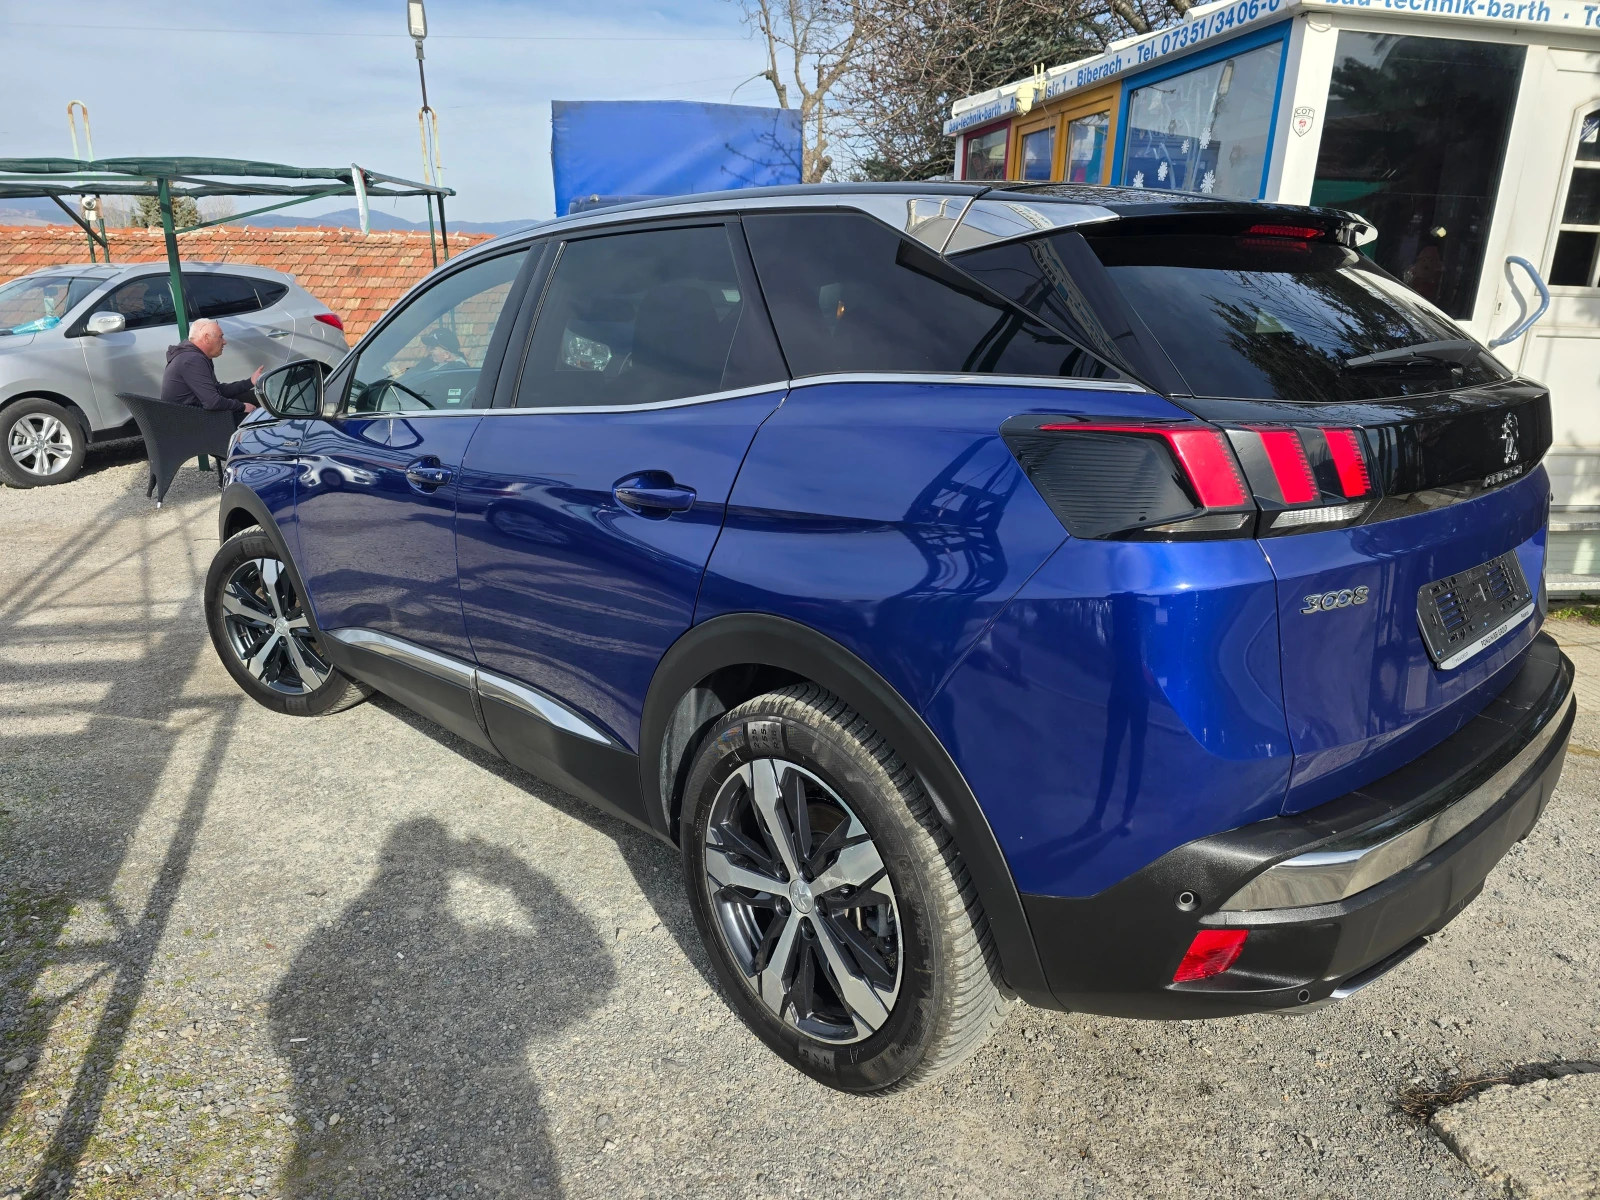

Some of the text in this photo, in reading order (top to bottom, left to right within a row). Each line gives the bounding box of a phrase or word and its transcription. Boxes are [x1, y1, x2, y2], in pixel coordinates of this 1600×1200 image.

[1325, 0, 1550, 21] echnik-barth
[948, 102, 1001, 133] bau-technik-barth
[1062, 75, 1067, 91] 1
[1077, 55, 1121, 87] Biberach
[1137, 40, 1157, 63] Tel.
[1299, 585, 1369, 614] 3008
[752, 728, 760, 749] 225
